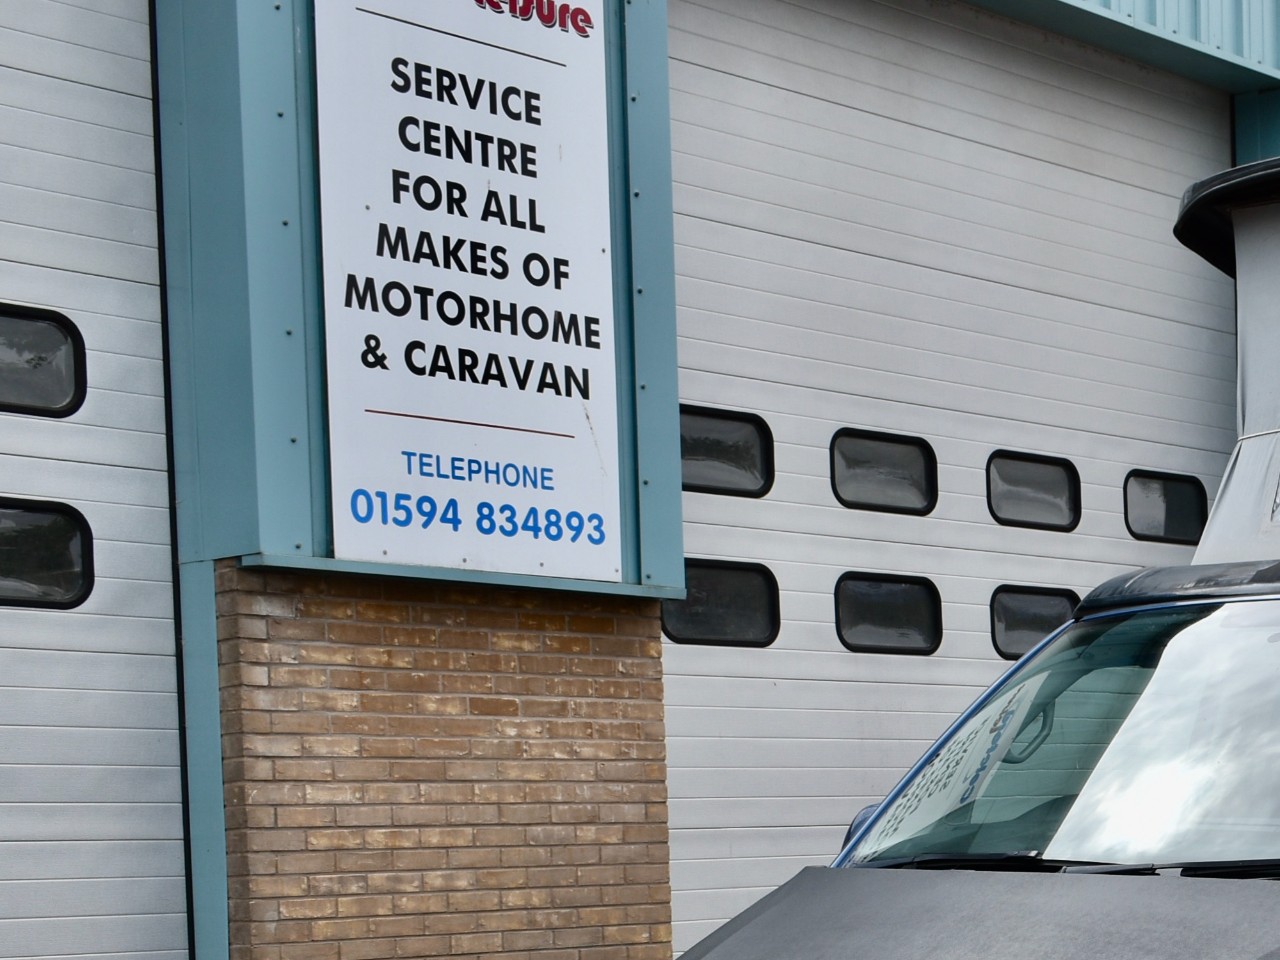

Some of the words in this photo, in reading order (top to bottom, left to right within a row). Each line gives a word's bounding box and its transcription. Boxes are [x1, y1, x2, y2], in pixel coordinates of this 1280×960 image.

[474, 0, 594, 38] sure
[391, 57, 541, 126] SERVICE
[399, 116, 538, 179] CENTRE
[392, 169, 469, 218] FOR
[480, 190, 546, 234] ALL
[376, 223, 510, 280] MAKES
[523, 253, 570, 290] OF
[344, 274, 601, 349] MOTORHOME
[360, 334, 390, 371] &
[404, 340, 590, 401] CARAVAN
[401, 451, 555, 491] TELEPHONE
[350, 488, 462, 532] 01594
[476, 501, 606, 546] 834893
